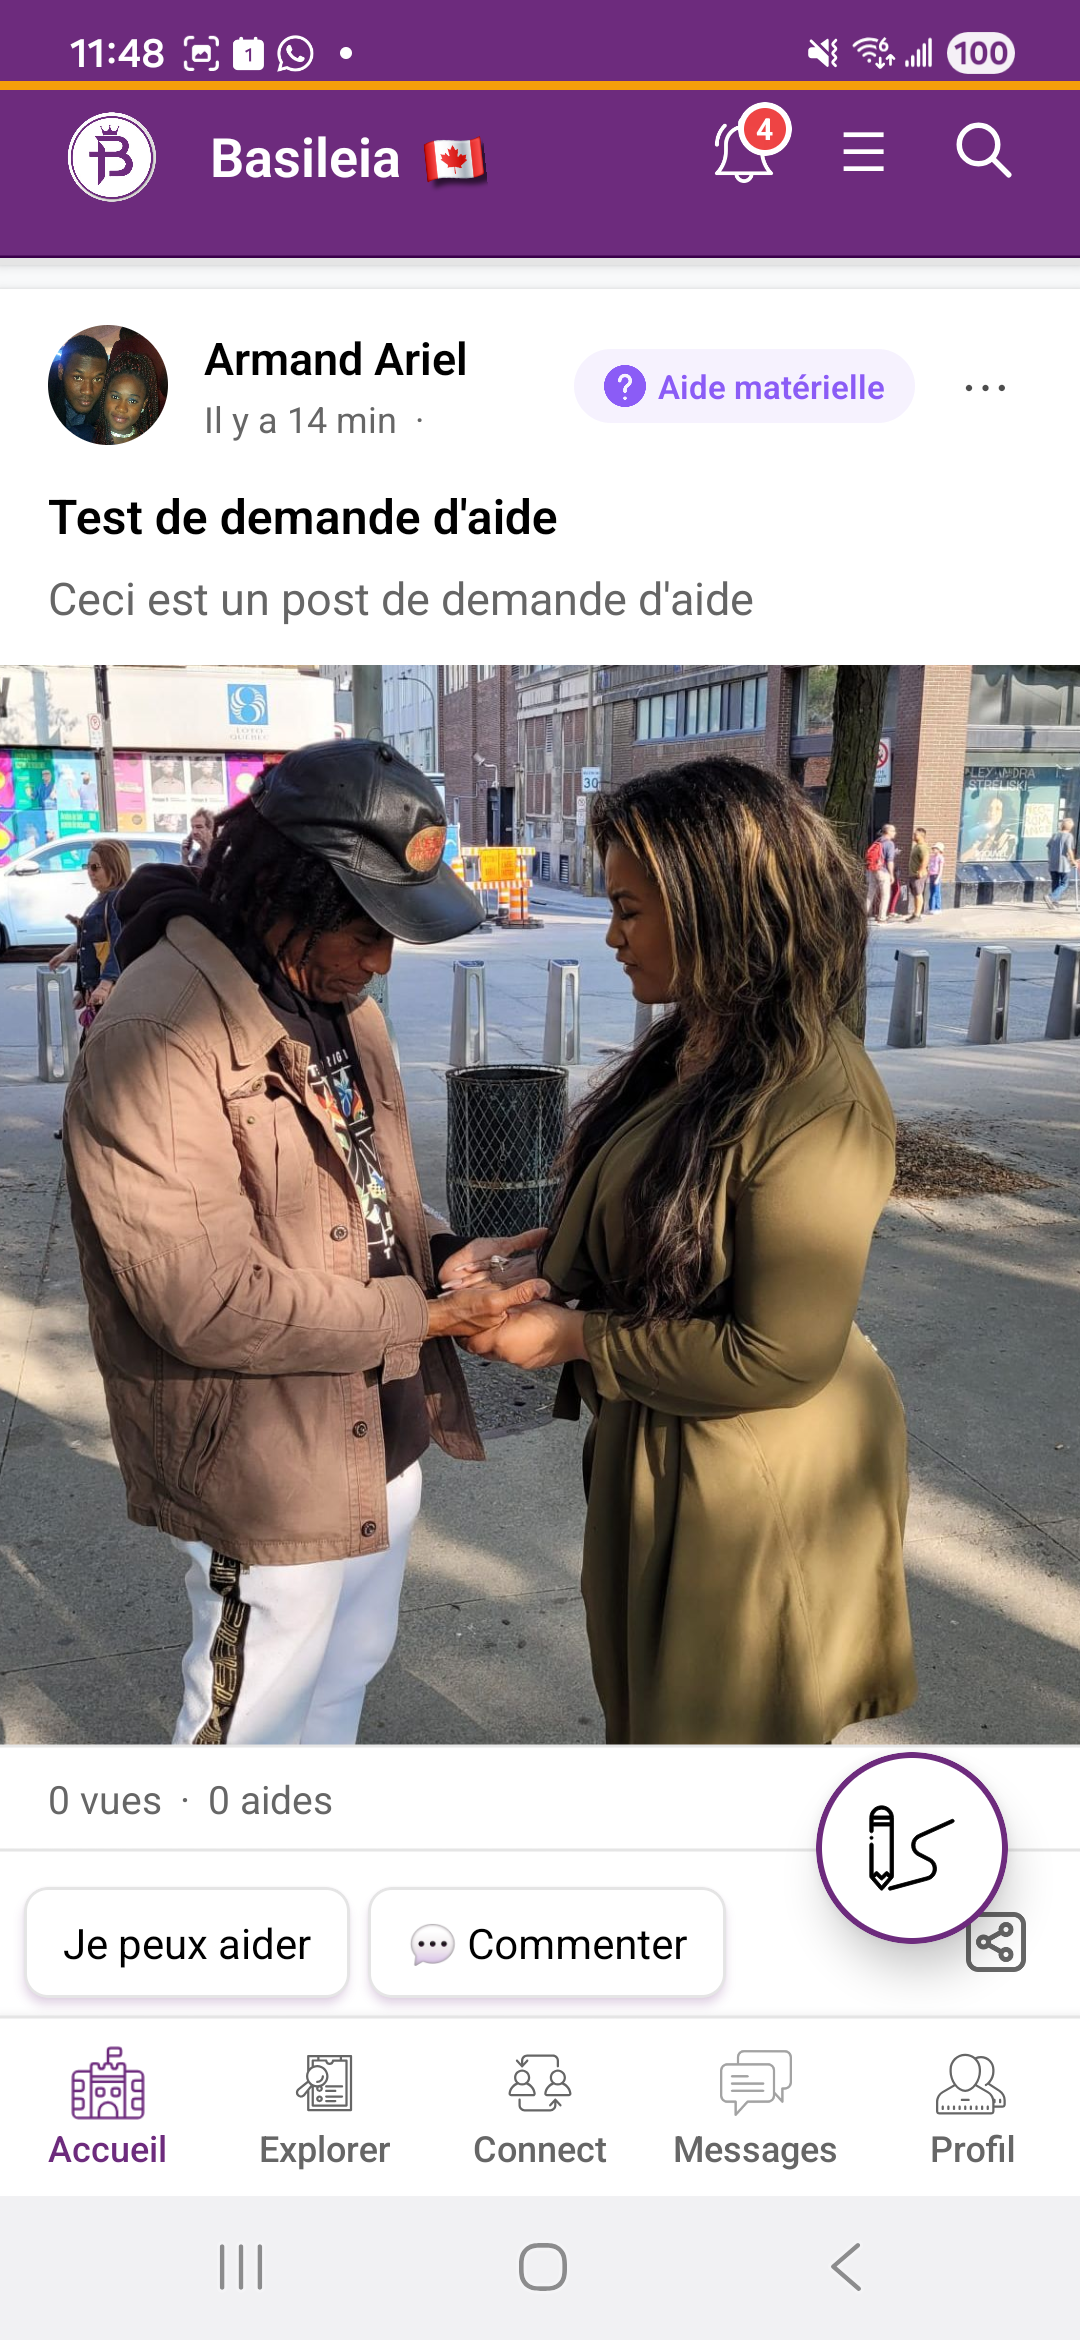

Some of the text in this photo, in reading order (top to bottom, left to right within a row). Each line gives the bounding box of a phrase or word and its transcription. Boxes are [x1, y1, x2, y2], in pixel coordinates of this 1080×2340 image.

[70, 38, 164, 68] 11:48
[245, 48, 252, 62] 1
[954, 41, 1008, 65] 100
[756, 117, 774, 141] 4
[213, 136, 399, 178] Basileia
[204, 341, 465, 376] Armand Ariel
[658, 373, 885, 400] Aide matérielle
[207, 406, 395, 442] Il y a 14 min
[49, 498, 557, 536] Test de demande d'aide
[50, 581, 752, 625] Ceci est un post de demande d'aide
[583, 777, 599, 789] 30
[965, 767, 1036, 779] LEXNDRA
[50, 1786, 161, 1816] 0 vues
[209, 1784, 332, 1816] 0 aides
[64, 1926, 312, 1969] Je peux aider
[468, 1927, 688, 1961] Commenter
[48, 2134, 166, 2164] Accueil
[260, 2134, 391, 2171] Explorer
[474, 2135, 607, 2164] Connect
[674, 2135, 837, 2171] Messages
[931, 2133, 1014, 2164] Profil
